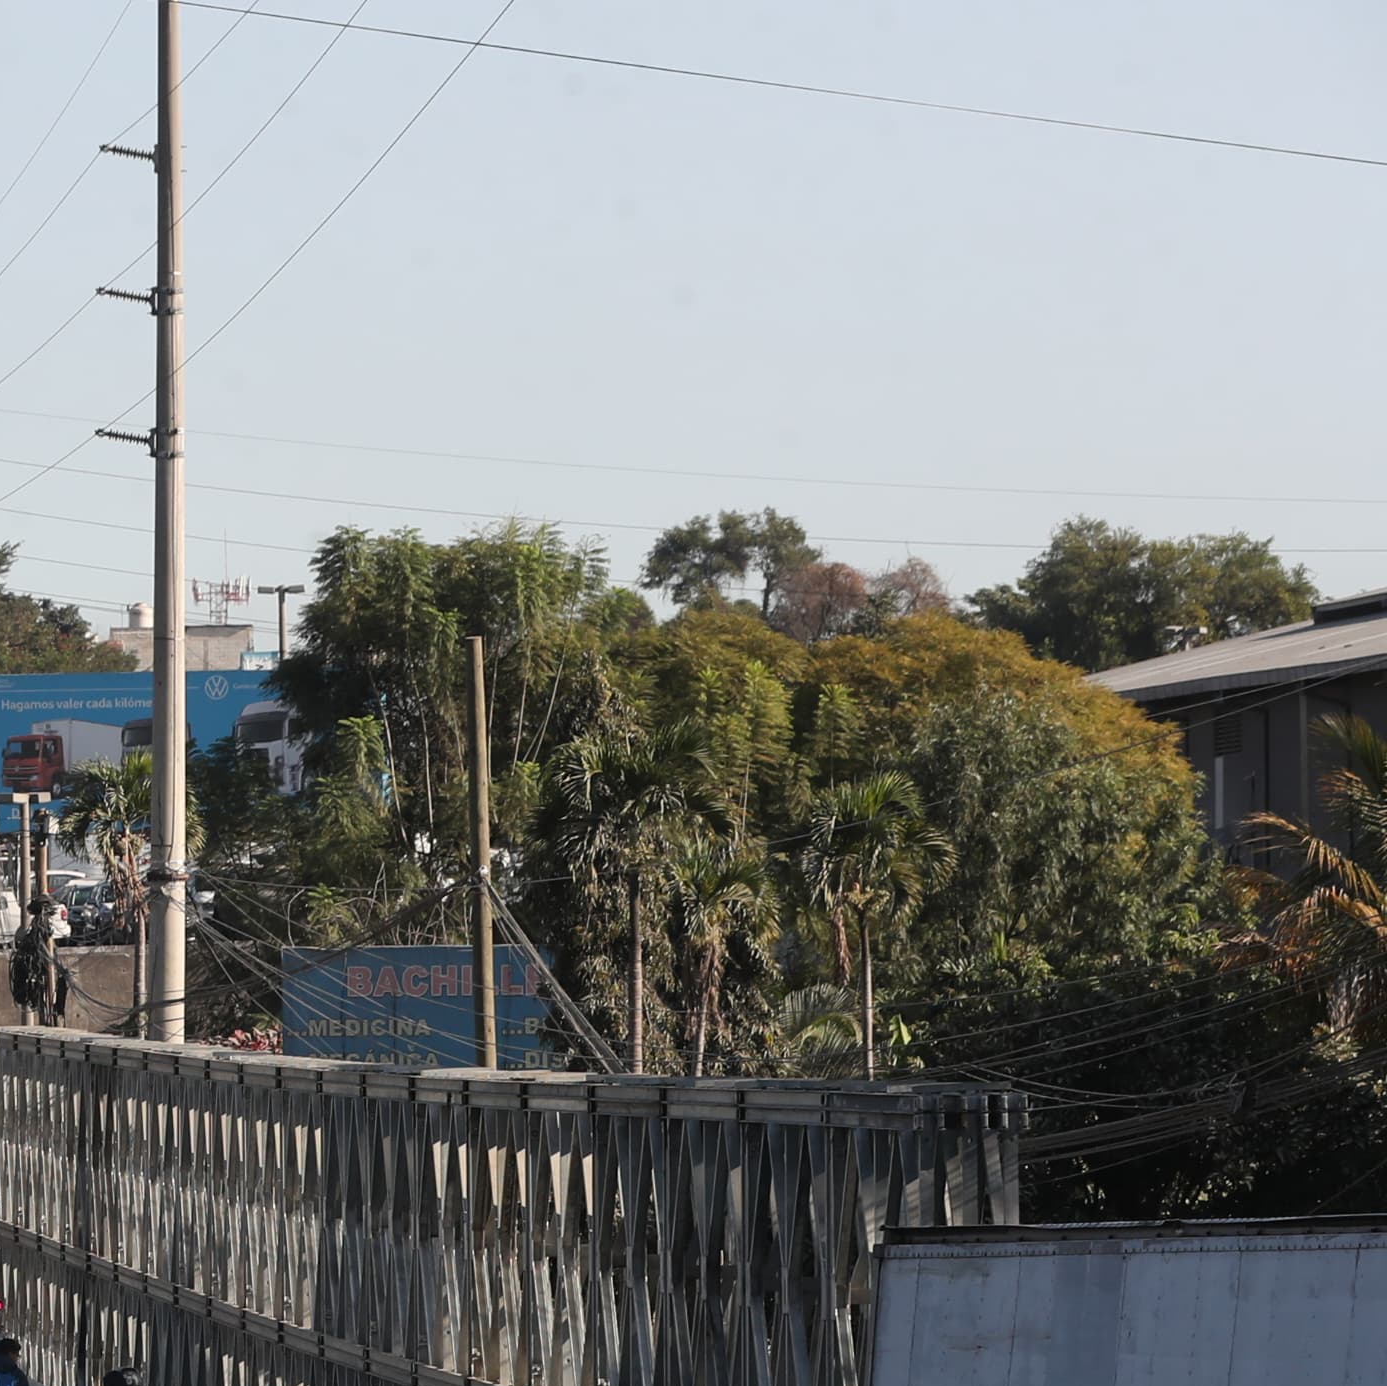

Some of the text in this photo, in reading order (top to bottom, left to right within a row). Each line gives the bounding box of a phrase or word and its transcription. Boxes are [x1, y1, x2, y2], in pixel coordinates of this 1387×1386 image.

[1, 698, 153, 713] Hagamos valer cada kilóme
